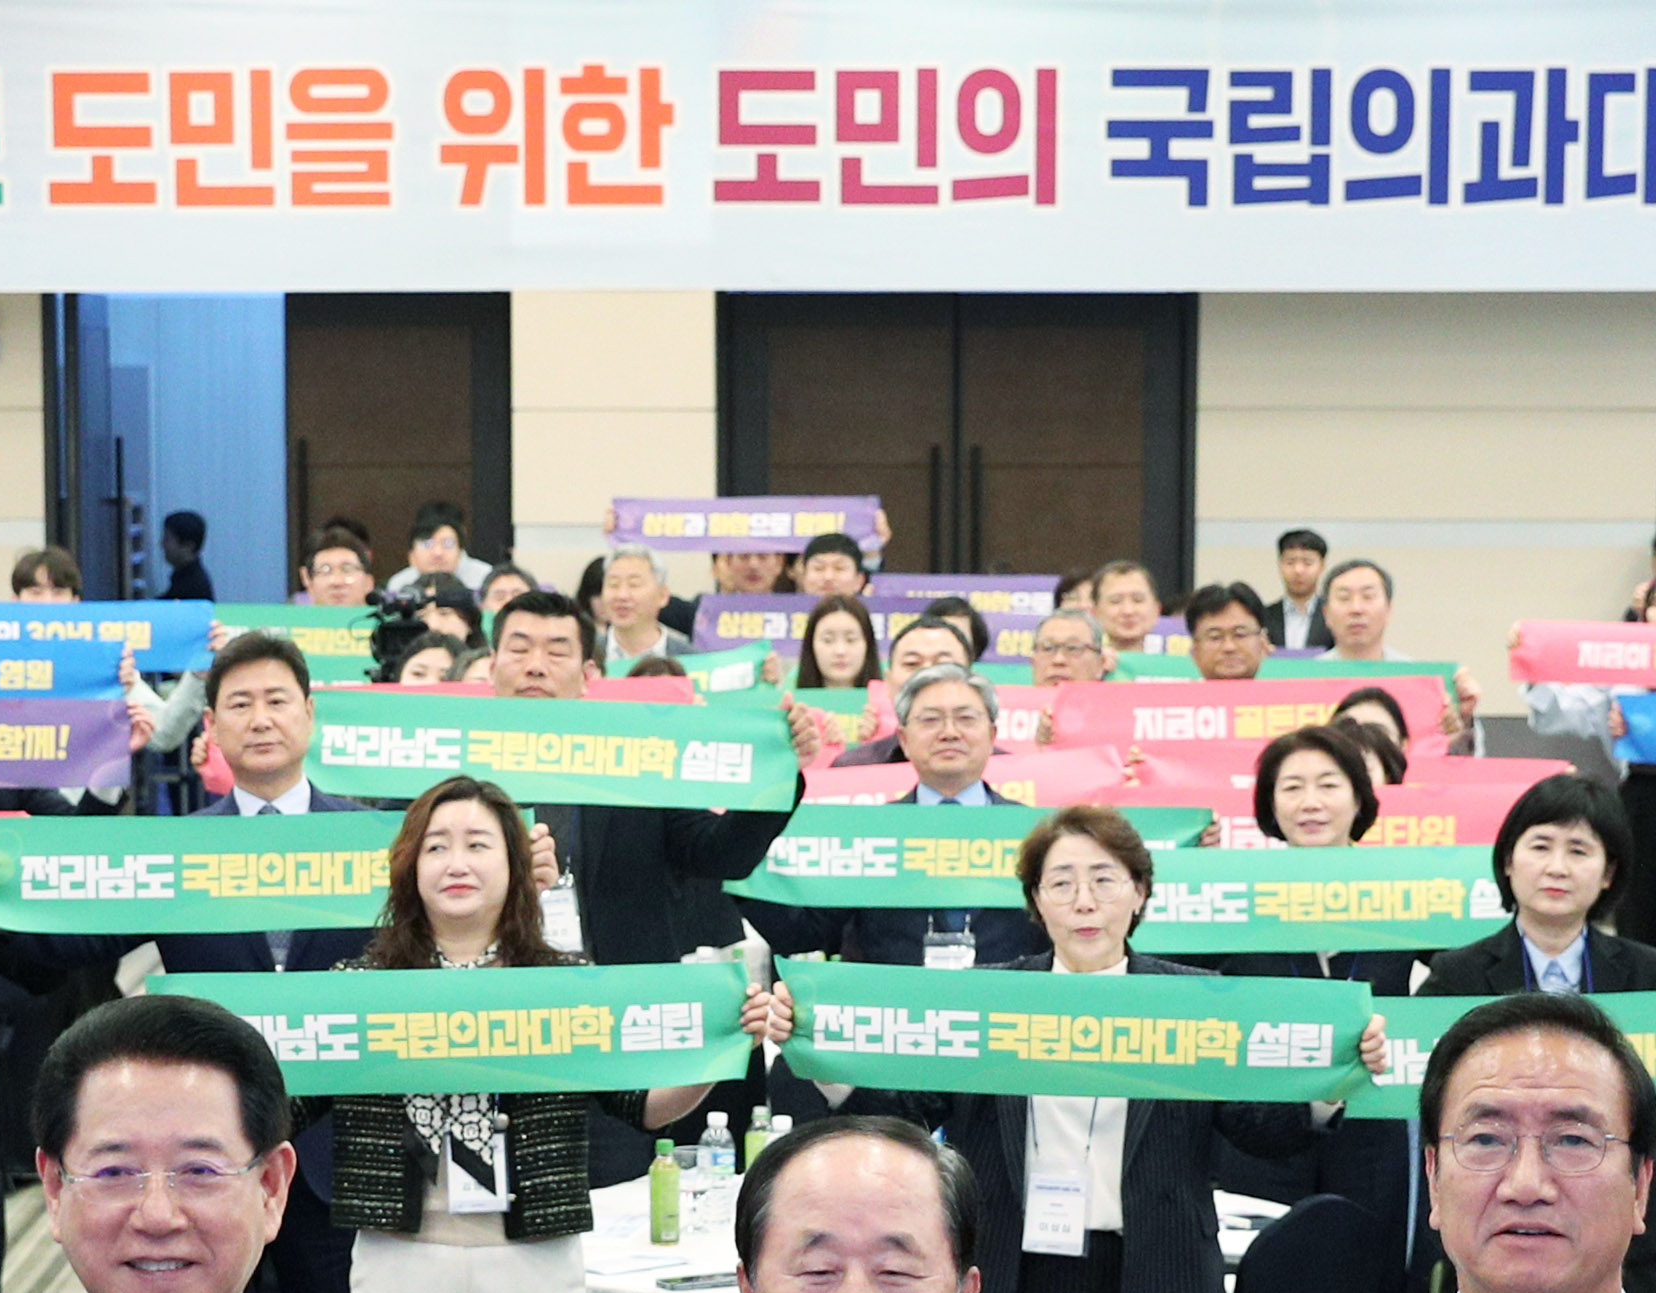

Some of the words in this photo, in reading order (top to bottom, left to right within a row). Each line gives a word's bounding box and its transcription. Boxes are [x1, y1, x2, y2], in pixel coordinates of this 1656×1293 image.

[49, 66, 393, 206] 도민을
[440, 64, 674, 206] 위한
[712, 67, 1057, 206] 도민의
[1133, 707, 1226, 742] 지금이
[320, 725, 461, 769] 전라남도
[466, 729, 678, 780] 국립의과대학
[680, 741, 754, 784] 설립
[1353, 815, 1456, 847] 타임
[20, 854, 174, 900] 전라남도
[767, 836, 898, 877] 전라남도
[903, 837, 1025, 878] 국립의
[1145, 881, 1249, 923] 라남도
[1254, 878, 1466, 923] 국립의과대학
[1469, 879, 1514, 921] 설
[248, 1013, 360, 1062] 남도
[366, 1003, 615, 1060] 국립의과대학
[620, 1002, 703, 1053] 설립
[813, 1003, 981, 1059] 전라남도
[988, 1011, 1242, 1066] 국립의과대학
[1246, 1020, 1334, 1069] 설립
